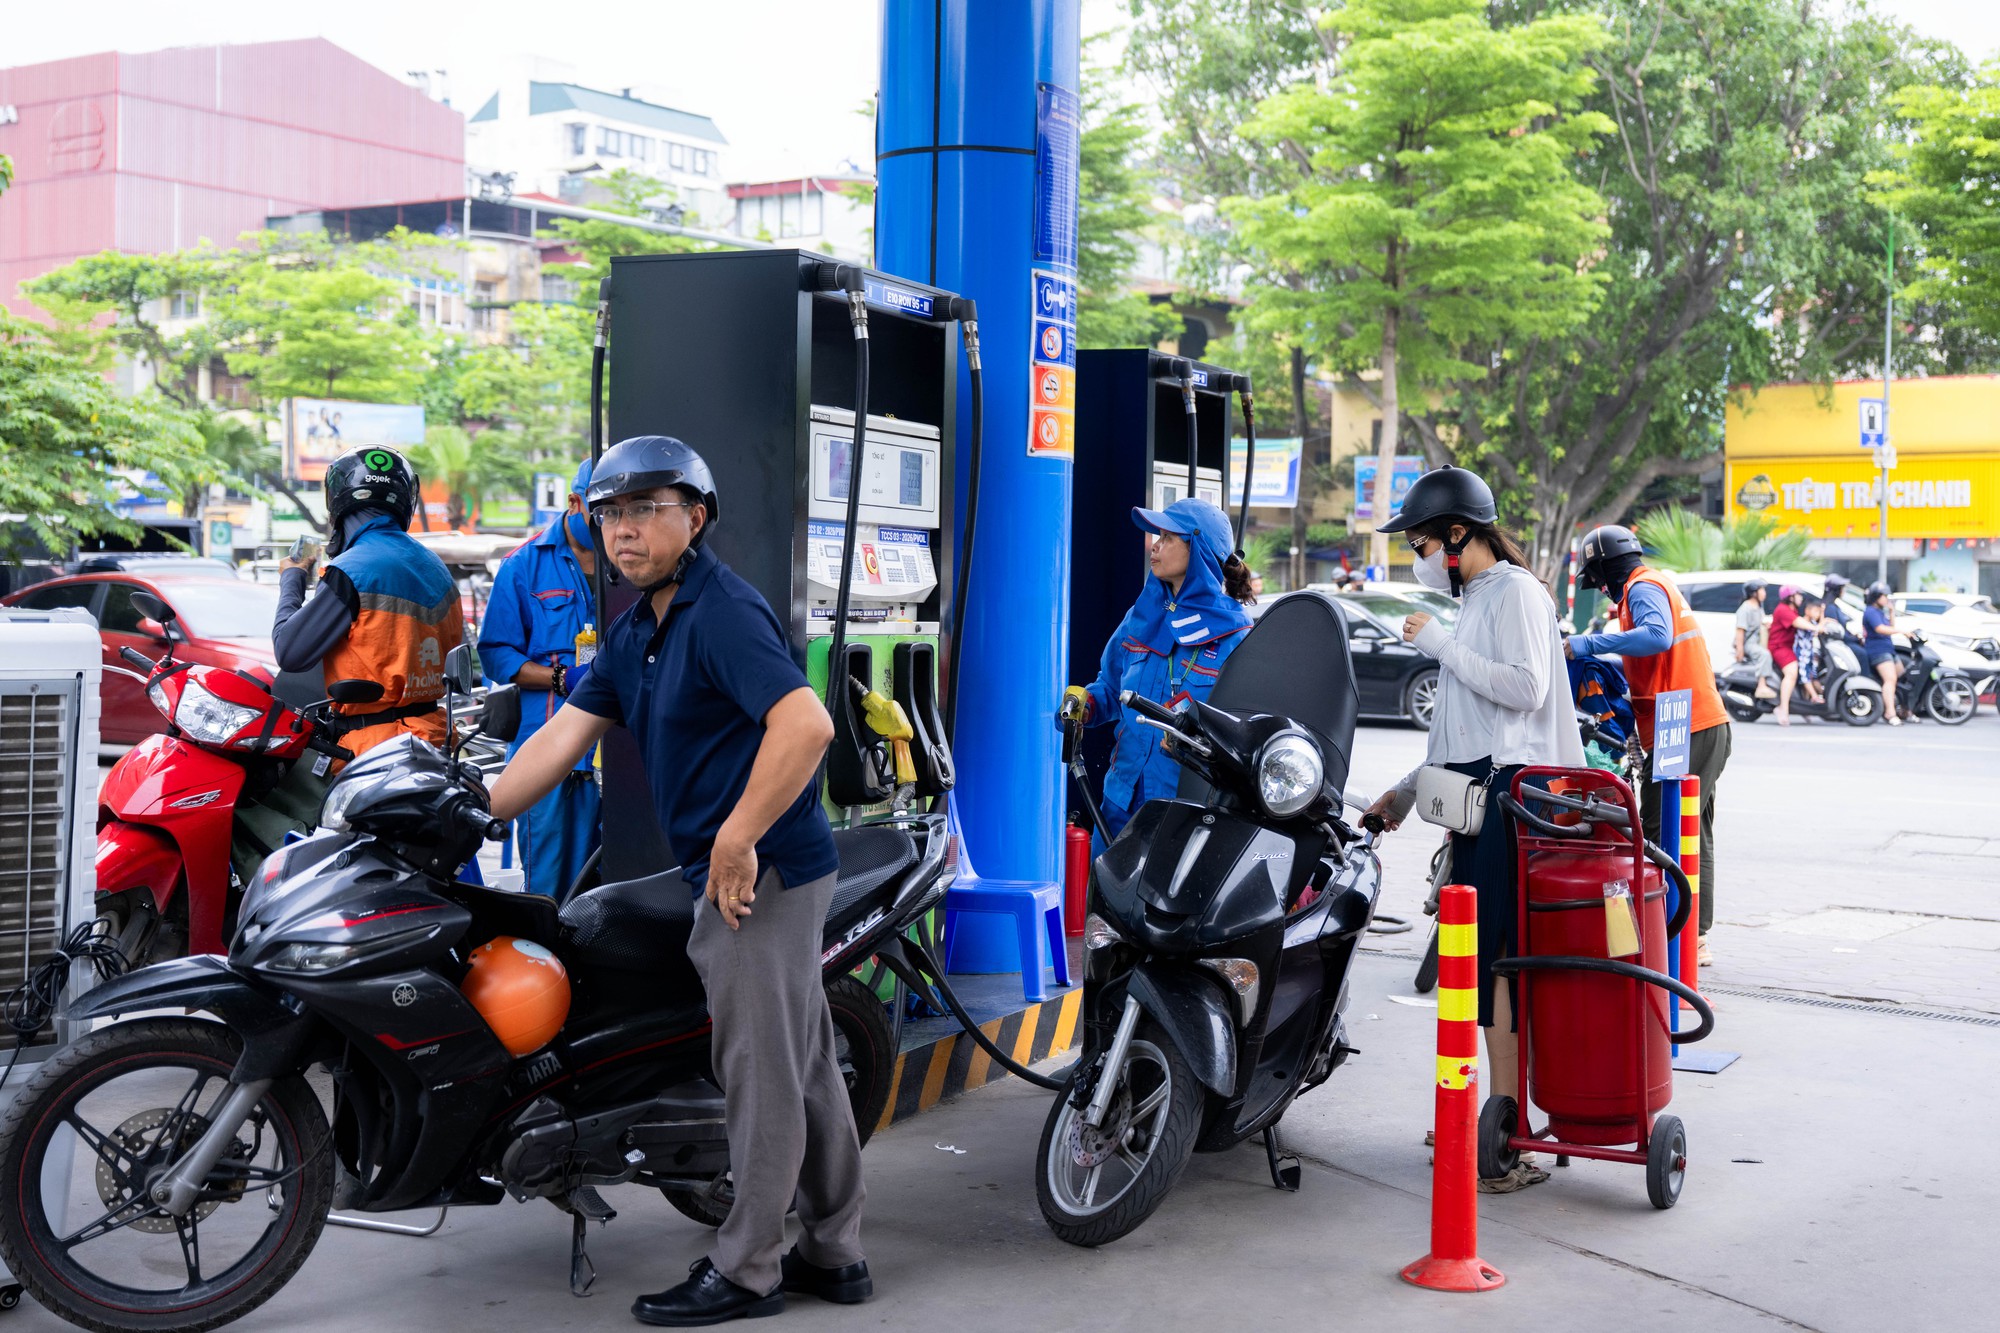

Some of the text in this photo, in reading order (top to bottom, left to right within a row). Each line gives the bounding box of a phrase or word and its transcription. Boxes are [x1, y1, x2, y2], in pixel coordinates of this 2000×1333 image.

[887, 291, 898, 304] E10
[898, 294, 911, 308] RON
[911, 298, 920, 310] 95
[365, 474, 391, 484] gojek
[1781, 477, 1836, 514] TIỆM
[1888, 480, 1971, 509] CHANH
[807, 524, 816, 534] CCS
[1660, 693, 1688, 722] LỐI VÀO
[1658, 722, 1687, 749] XE MÁY
[503, 1053, 563, 1097] YAHA
